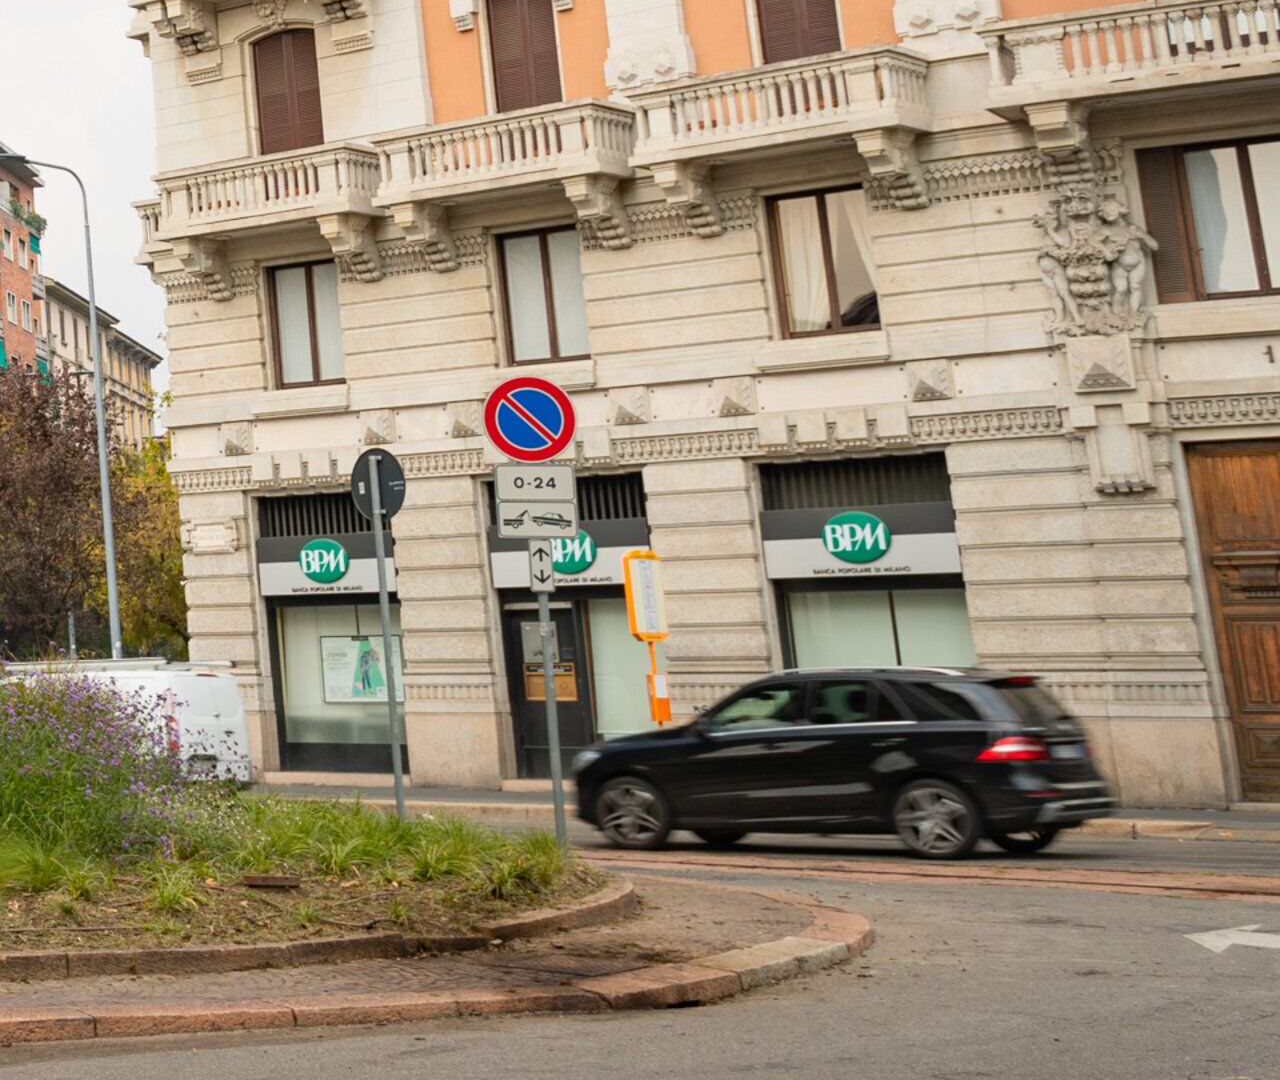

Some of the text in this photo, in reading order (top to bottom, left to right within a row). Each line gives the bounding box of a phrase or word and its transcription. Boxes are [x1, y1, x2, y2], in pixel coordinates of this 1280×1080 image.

[513, 476, 557, 489] 0-24
[824, 522, 887, 552] BPM
[301, 549, 346, 573] BPM
